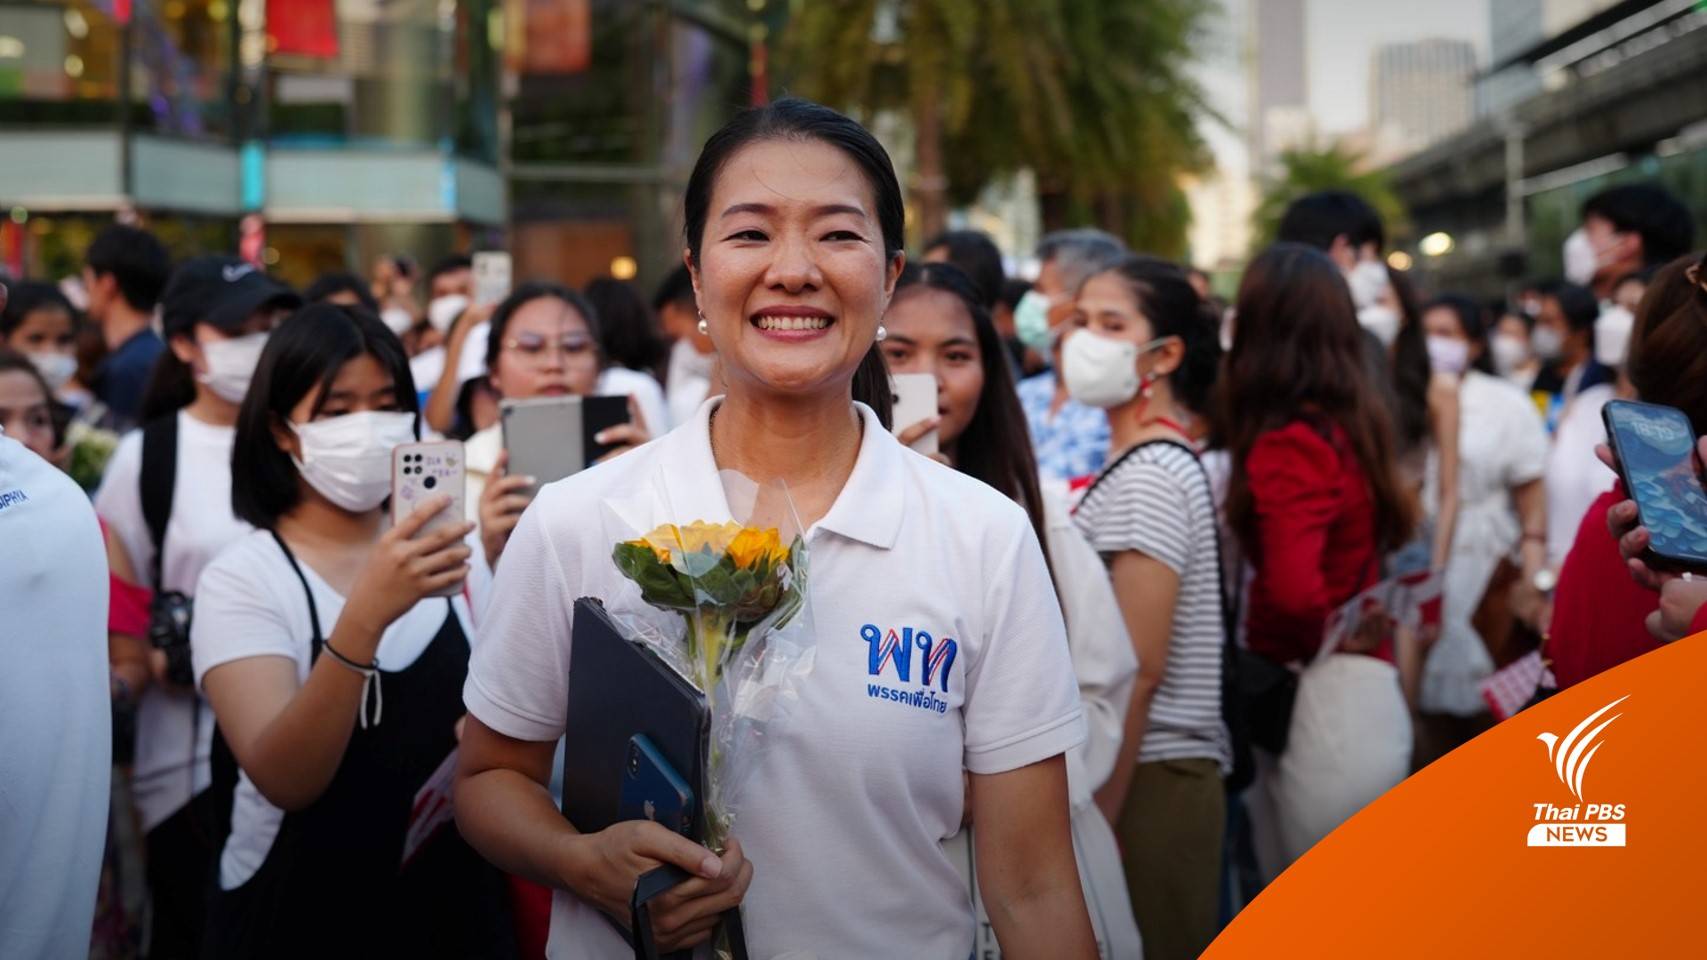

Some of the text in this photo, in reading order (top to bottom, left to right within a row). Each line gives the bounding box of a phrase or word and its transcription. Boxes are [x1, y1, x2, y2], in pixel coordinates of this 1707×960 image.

[860, 623, 957, 693] พท
[867, 683, 948, 714] พรรคเพื่อไทย
